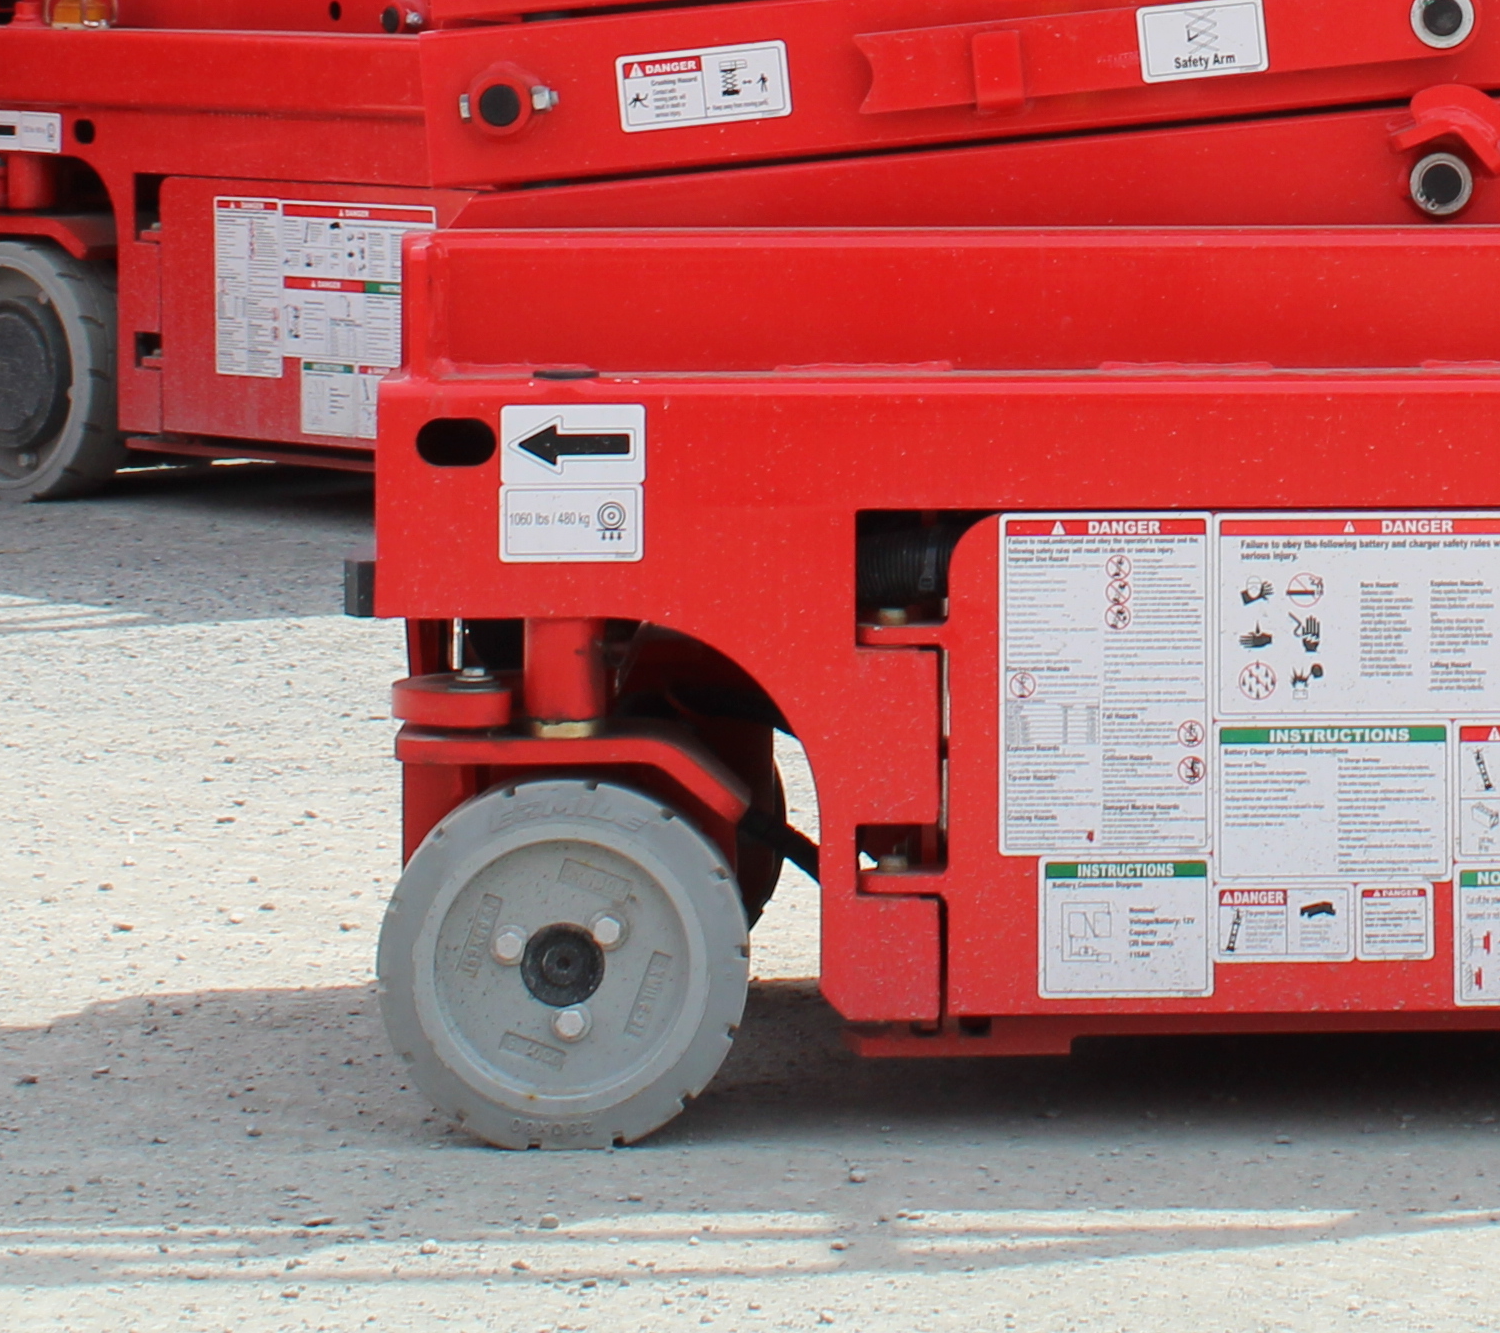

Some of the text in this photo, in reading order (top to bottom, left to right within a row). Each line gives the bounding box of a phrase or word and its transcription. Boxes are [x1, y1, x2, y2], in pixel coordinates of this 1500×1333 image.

[645, 61, 696, 75] DANGER
[1174, 54, 1236, 70] Safety Arm
[651, 78, 676, 86] Crushing
[510, 514, 532, 526] 1060
[535, 513, 550, 526] lbs
[558, 513, 576, 526] 480
[579, 513, 590, 528] kg
[1382, 520, 1453, 533] DANGER
[1088, 521, 1161, 534] DANGER
[1240, 540, 1269, 549] Failure
[1271, 540, 1279, 549] to
[1282, 540, 1301, 550] obey
[1304, 540, 1318, 549] the
[1319, 540, 1357, 550] following
[1359, 540, 1389, 550] battery
[1392, 540, 1406, 548] and
[1409, 540, 1440, 549] charger
[1443, 539, 1468, 549] safety
[1470, 539, 1490, 548] rules
[1240, 551, 1298, 561] serious injury.
[1269, 729, 1410, 742] INSTRUCTIONS
[1277, 748, 1308, 756] Operating
[1077, 863, 1174, 877] INSTRUCTIONS
[1234, 892, 1284, 904] DANGER
